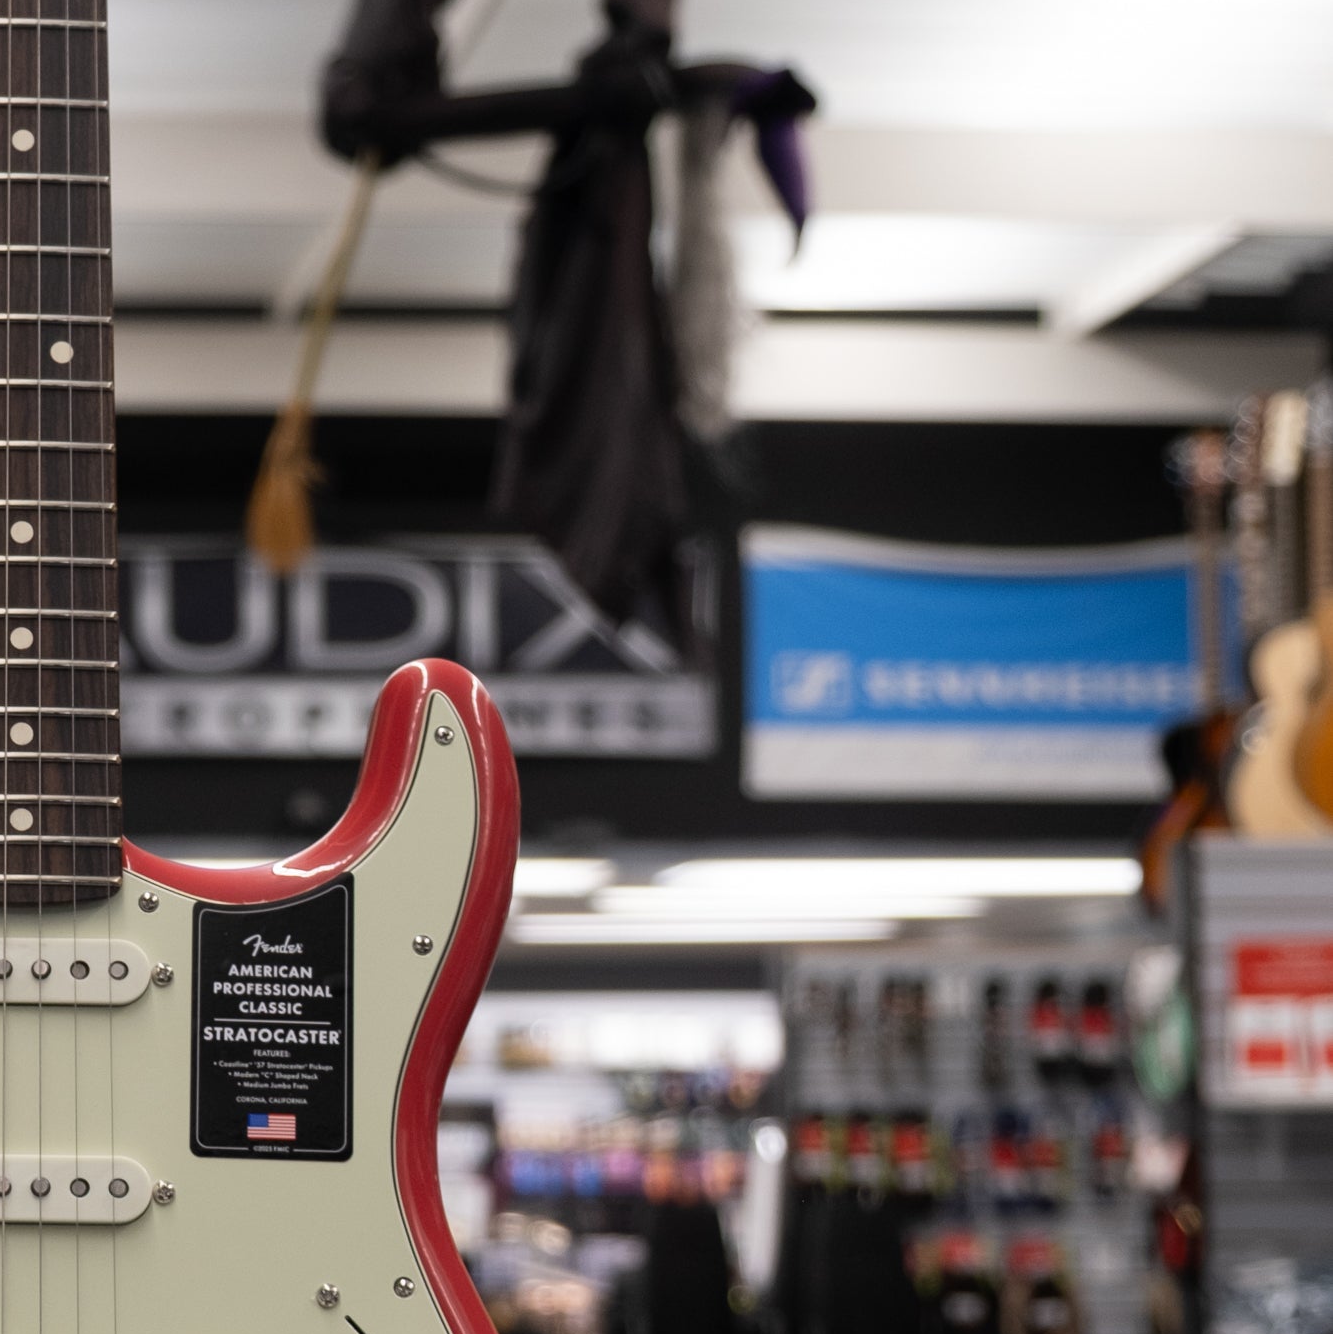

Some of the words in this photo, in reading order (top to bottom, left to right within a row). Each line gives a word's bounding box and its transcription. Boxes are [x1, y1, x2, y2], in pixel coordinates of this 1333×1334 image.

[121, 545, 686, 672] UDIX
[243, 934, 303, 957] Fender
[228, 964, 313, 979] AMERICAN
[213, 981, 333, 999] PROFESSIONAL
[239, 1000, 303, 1015] CLASSIC
[253, 1049, 291, 1058] FEATURES:
[268, 1097, 308, 1105] CALIFORNIA
